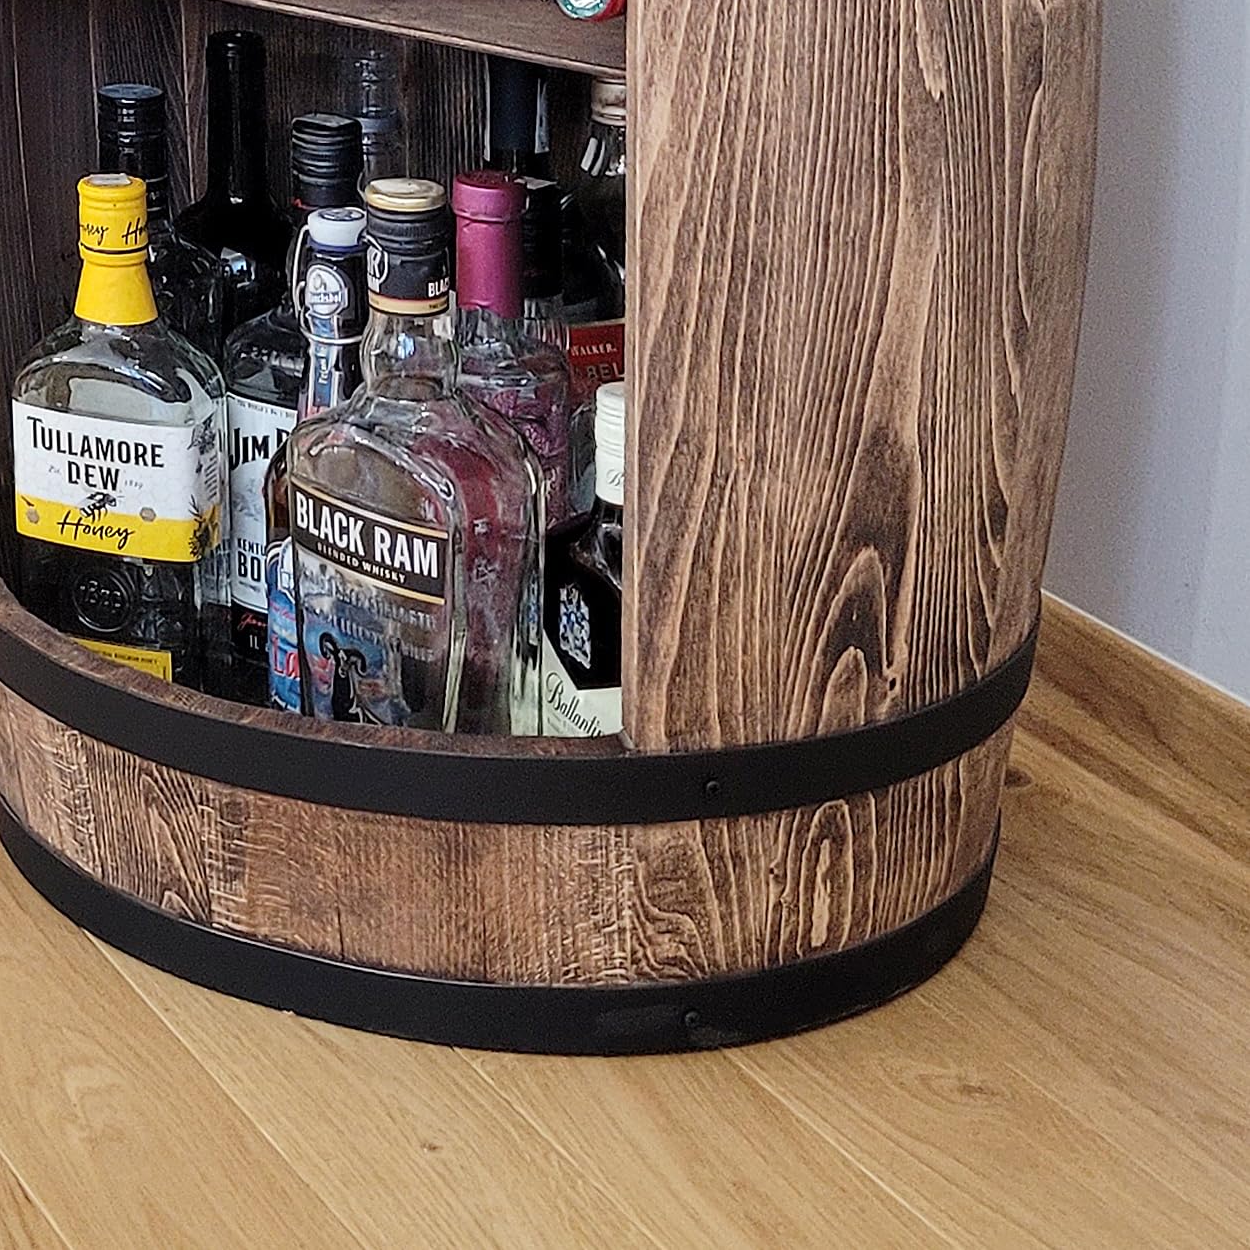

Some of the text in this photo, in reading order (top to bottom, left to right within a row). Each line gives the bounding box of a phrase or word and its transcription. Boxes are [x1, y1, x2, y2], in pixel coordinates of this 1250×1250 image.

[27, 415, 165, 468] TULLAMORE
[229, 427, 270, 470] JIM
[57, 510, 136, 551] Honey
[296, 490, 438, 579] BLACK RAM
[317, 542, 406, 584] BLENDED WHISKY
